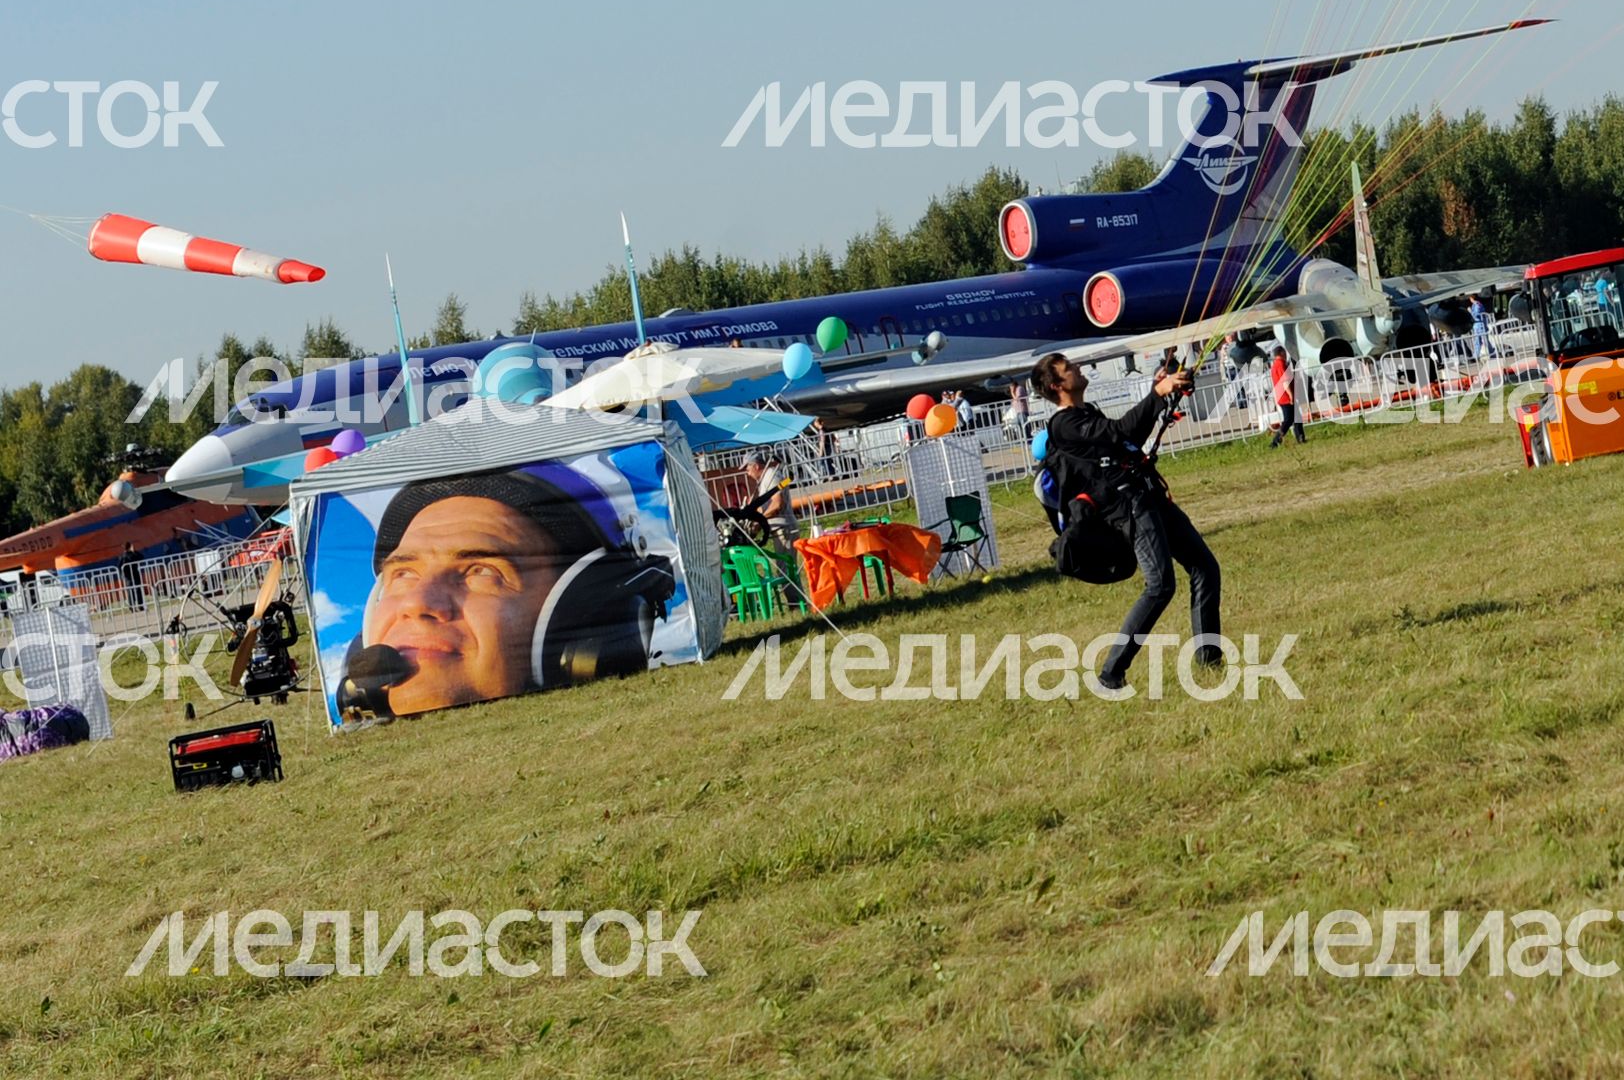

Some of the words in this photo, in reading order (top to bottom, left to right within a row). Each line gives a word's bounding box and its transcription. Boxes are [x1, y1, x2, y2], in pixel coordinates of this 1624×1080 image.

[1096, 213, 1139, 228] RA-85317
[914, 302, 945, 311] FLIGHT
[947, 296, 993, 306] RESEARCH
[994, 290, 1036, 300] INSTITUTE
[945, 289, 996, 300] GROMOV
